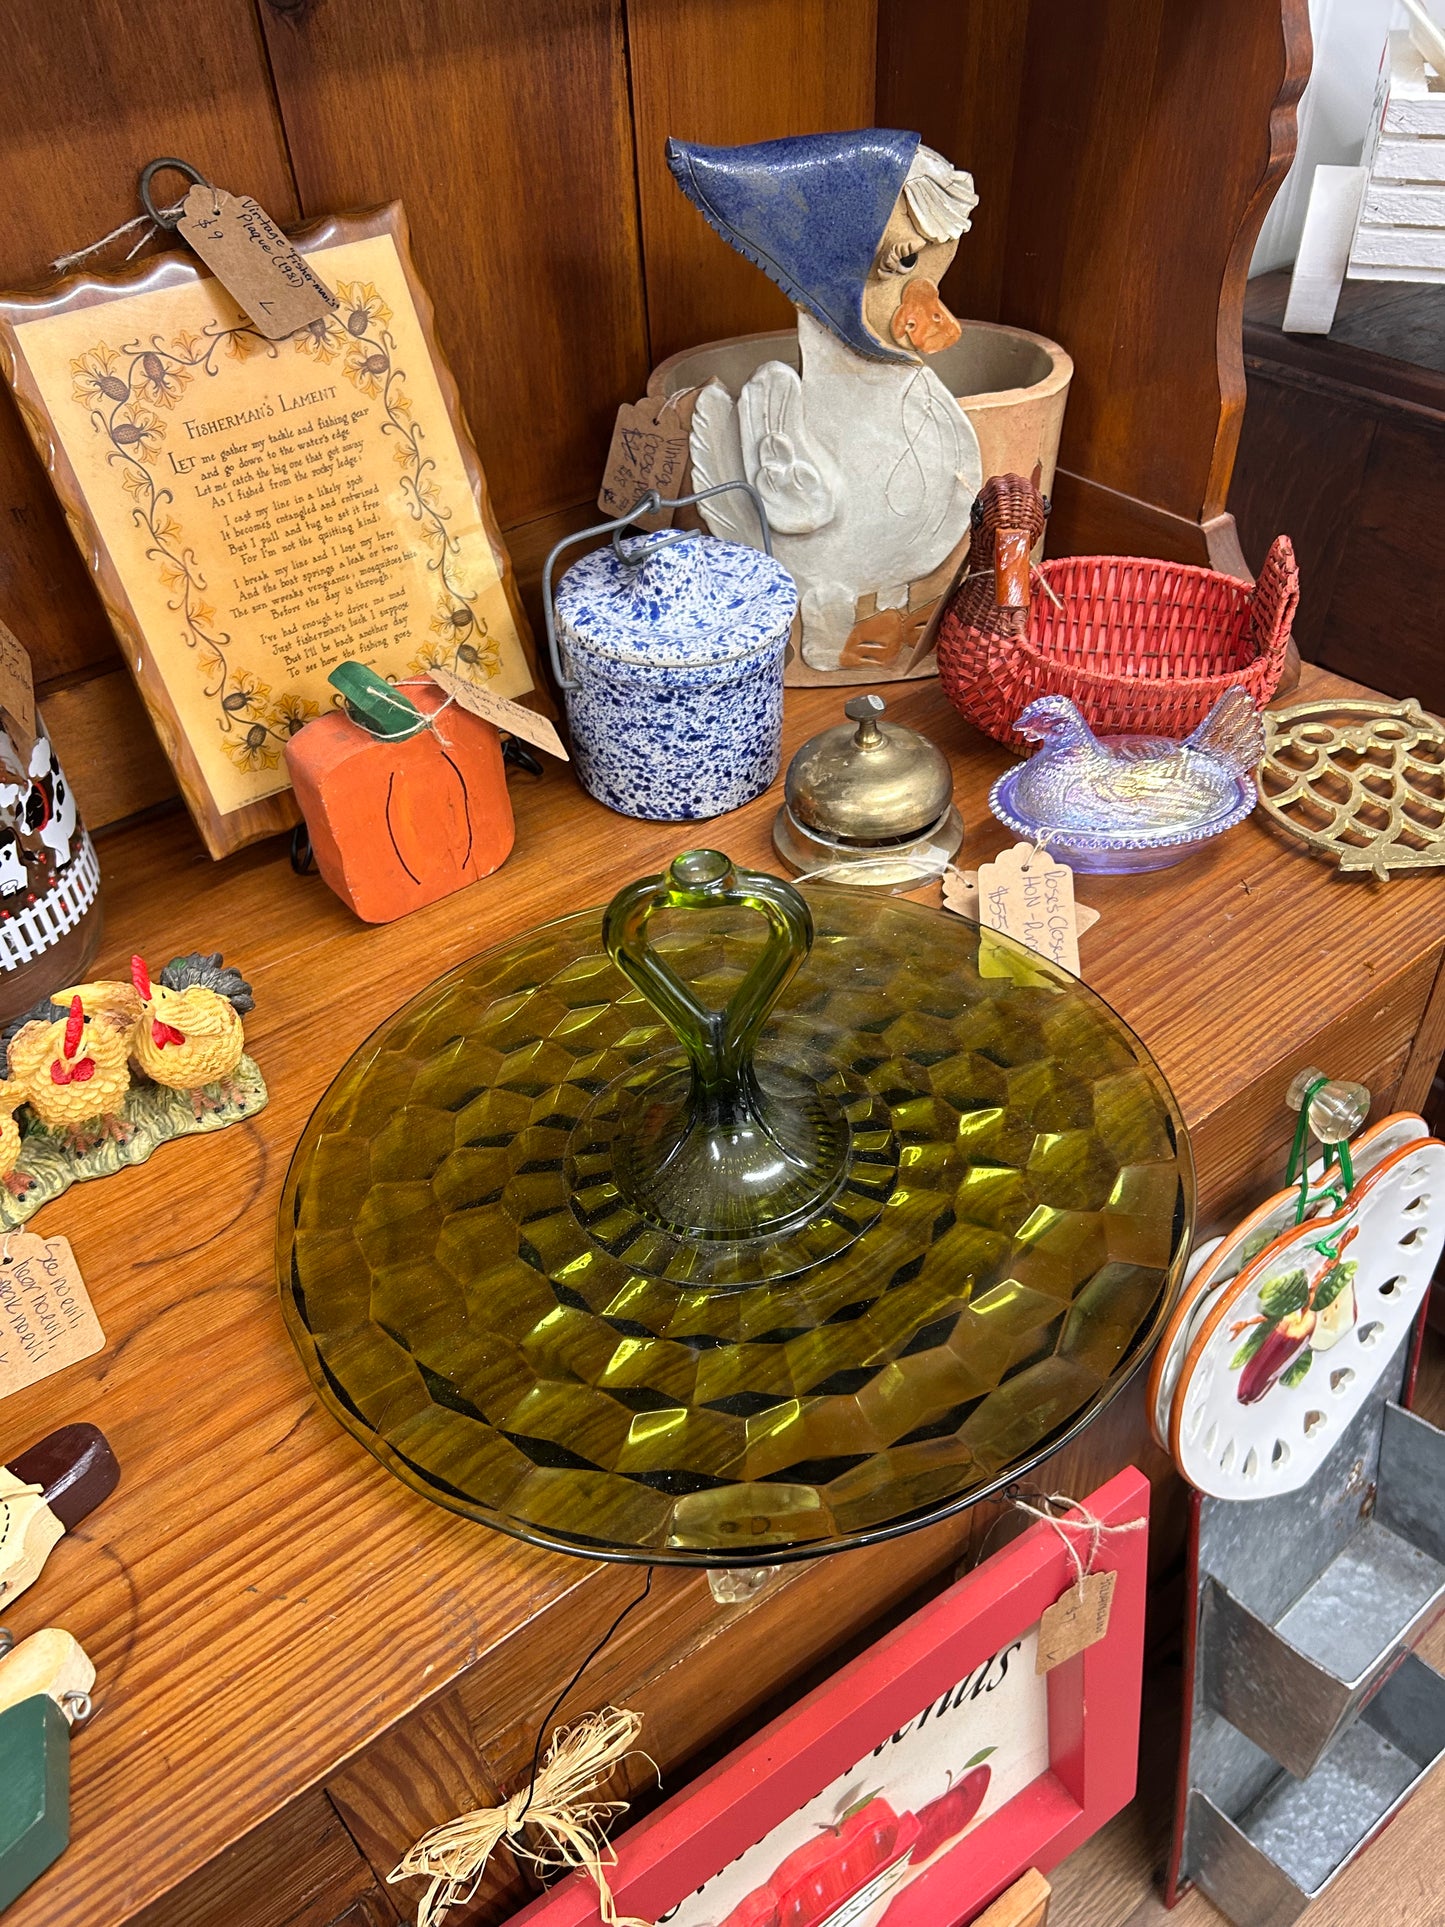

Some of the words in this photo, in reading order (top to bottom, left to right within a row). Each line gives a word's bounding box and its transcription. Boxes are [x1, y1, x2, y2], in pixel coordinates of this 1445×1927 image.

[236, 213, 274, 256] Plaque
[241, 199, 286, 248] Vintage
[278, 386, 336, 412] LAMENT
[201, 454, 216, 464] me
[220, 444, 247, 462] gather
[251, 440, 265, 453] my
[268, 429, 294, 443] tackle
[298, 422, 314, 435] and
[318, 414, 349, 429] fishing
[351, 408, 369, 423] gear
[201, 467, 219, 481] and
[224, 465, 234, 477] go
[239, 456, 263, 468] down
[267, 451, 276, 459] to
[279, 446, 295, 455] the
[297, 434, 329, 450] water's
[332, 429, 350, 441] edge
[194, 485, 212, 497] Let
[214, 482, 227, 492] me
[232, 472, 254, 487] catch
[256, 467, 270, 478] the
[272, 464, 288, 475] big
[289, 460, 303, 468] one
[305, 451, 323, 464] that
[327, 446, 340, 461] got
[655, 438, 687, 487] Vintage
[212, 497, 225, 508] As
[227, 492, 234, 502] I
[237, 483, 264, 500] fished
[269, 474, 291, 489] from
[294, 471, 308, 482] the
[224, 515, 230, 526] I
[235, 510, 251, 523] cast
[255, 507, 268, 519] my
[272, 500, 290, 511] line
[294, 496, 304, 504] in
[317, 483, 341, 497] likely
[347, 475, 363, 491] spot
[220, 530, 230, 541] It
[233, 518, 271, 537] becomes
[276, 503, 317, 524] entangled
[320, 497, 336, 511] and
[228, 541, 247, 555] But
[250, 537, 256, 548] I
[260, 530, 279, 549] pull
[285, 523, 302, 537] and
[305, 520, 323, 531] tug
[324, 515, 333, 523] to
[338, 508, 349, 521] set
[352, 505, 360, 515] it
[363, 501, 380, 511] free
[233, 579, 239, 589] I
[243, 570, 269, 586] break
[274, 566, 288, 580] my
[291, 560, 308, 569] line
[313, 550, 328, 563] and
[331, 546, 337, 556] I
[340, 544, 356, 553] lose
[360, 537, 372, 549] my
[376, 531, 394, 541] lure
[240, 553, 257, 565] For
[260, 546, 277, 558] I'm
[282, 541, 296, 552] not
[298, 536, 312, 546] the
[318, 525, 354, 545] quitting
[239, 587, 259, 602] And
[263, 582, 277, 593] the
[279, 575, 298, 588] boat
[303, 565, 334, 583] springs
[346, 552, 365, 566] leak
[369, 550, 378, 558] or
[381, 544, 398, 553] two
[229, 608, 248, 618] The
[252, 603, 268, 613] sun
[271, 589, 304, 605] wreaks
[260, 634, 277, 644] I've
[281, 623, 298, 637] had
[302, 613, 332, 630] enough
[347, 603, 368, 614] drive
[373, 597, 384, 605] me
[388, 586, 405, 600] mad
[270, 605, 300, 619] Before
[305, 598, 319, 608] the
[325, 591, 340, 605] day
[344, 586, 353, 594] is
[272, 642, 292, 655] Just
[296, 624, 346, 646] fisherman's
[348, 614, 367, 627] luck
[370, 610, 376, 620] I
[283, 653, 302, 665] But
[304, 646, 317, 658] I'll
[321, 643, 330, 652] be
[333, 634, 354, 647] back
[359, 624, 388, 639] another
[393, 615, 408, 628] day
[287, 666, 300, 678] To
[306, 663, 317, 673] see
[320, 656, 338, 667] how
[343, 650, 356, 658] the
[359, 638, 389, 653] fishing
[988, 885, 1011, 930] $55
[1047, 916, 1070, 965] Closet
[36, 1243, 61, 1277] See
[50, 1276, 71, 1296] no
[30, 1292, 50, 1315] no
[9, 1313, 29, 1335] no
[20, 1333, 50, 1363] evil
